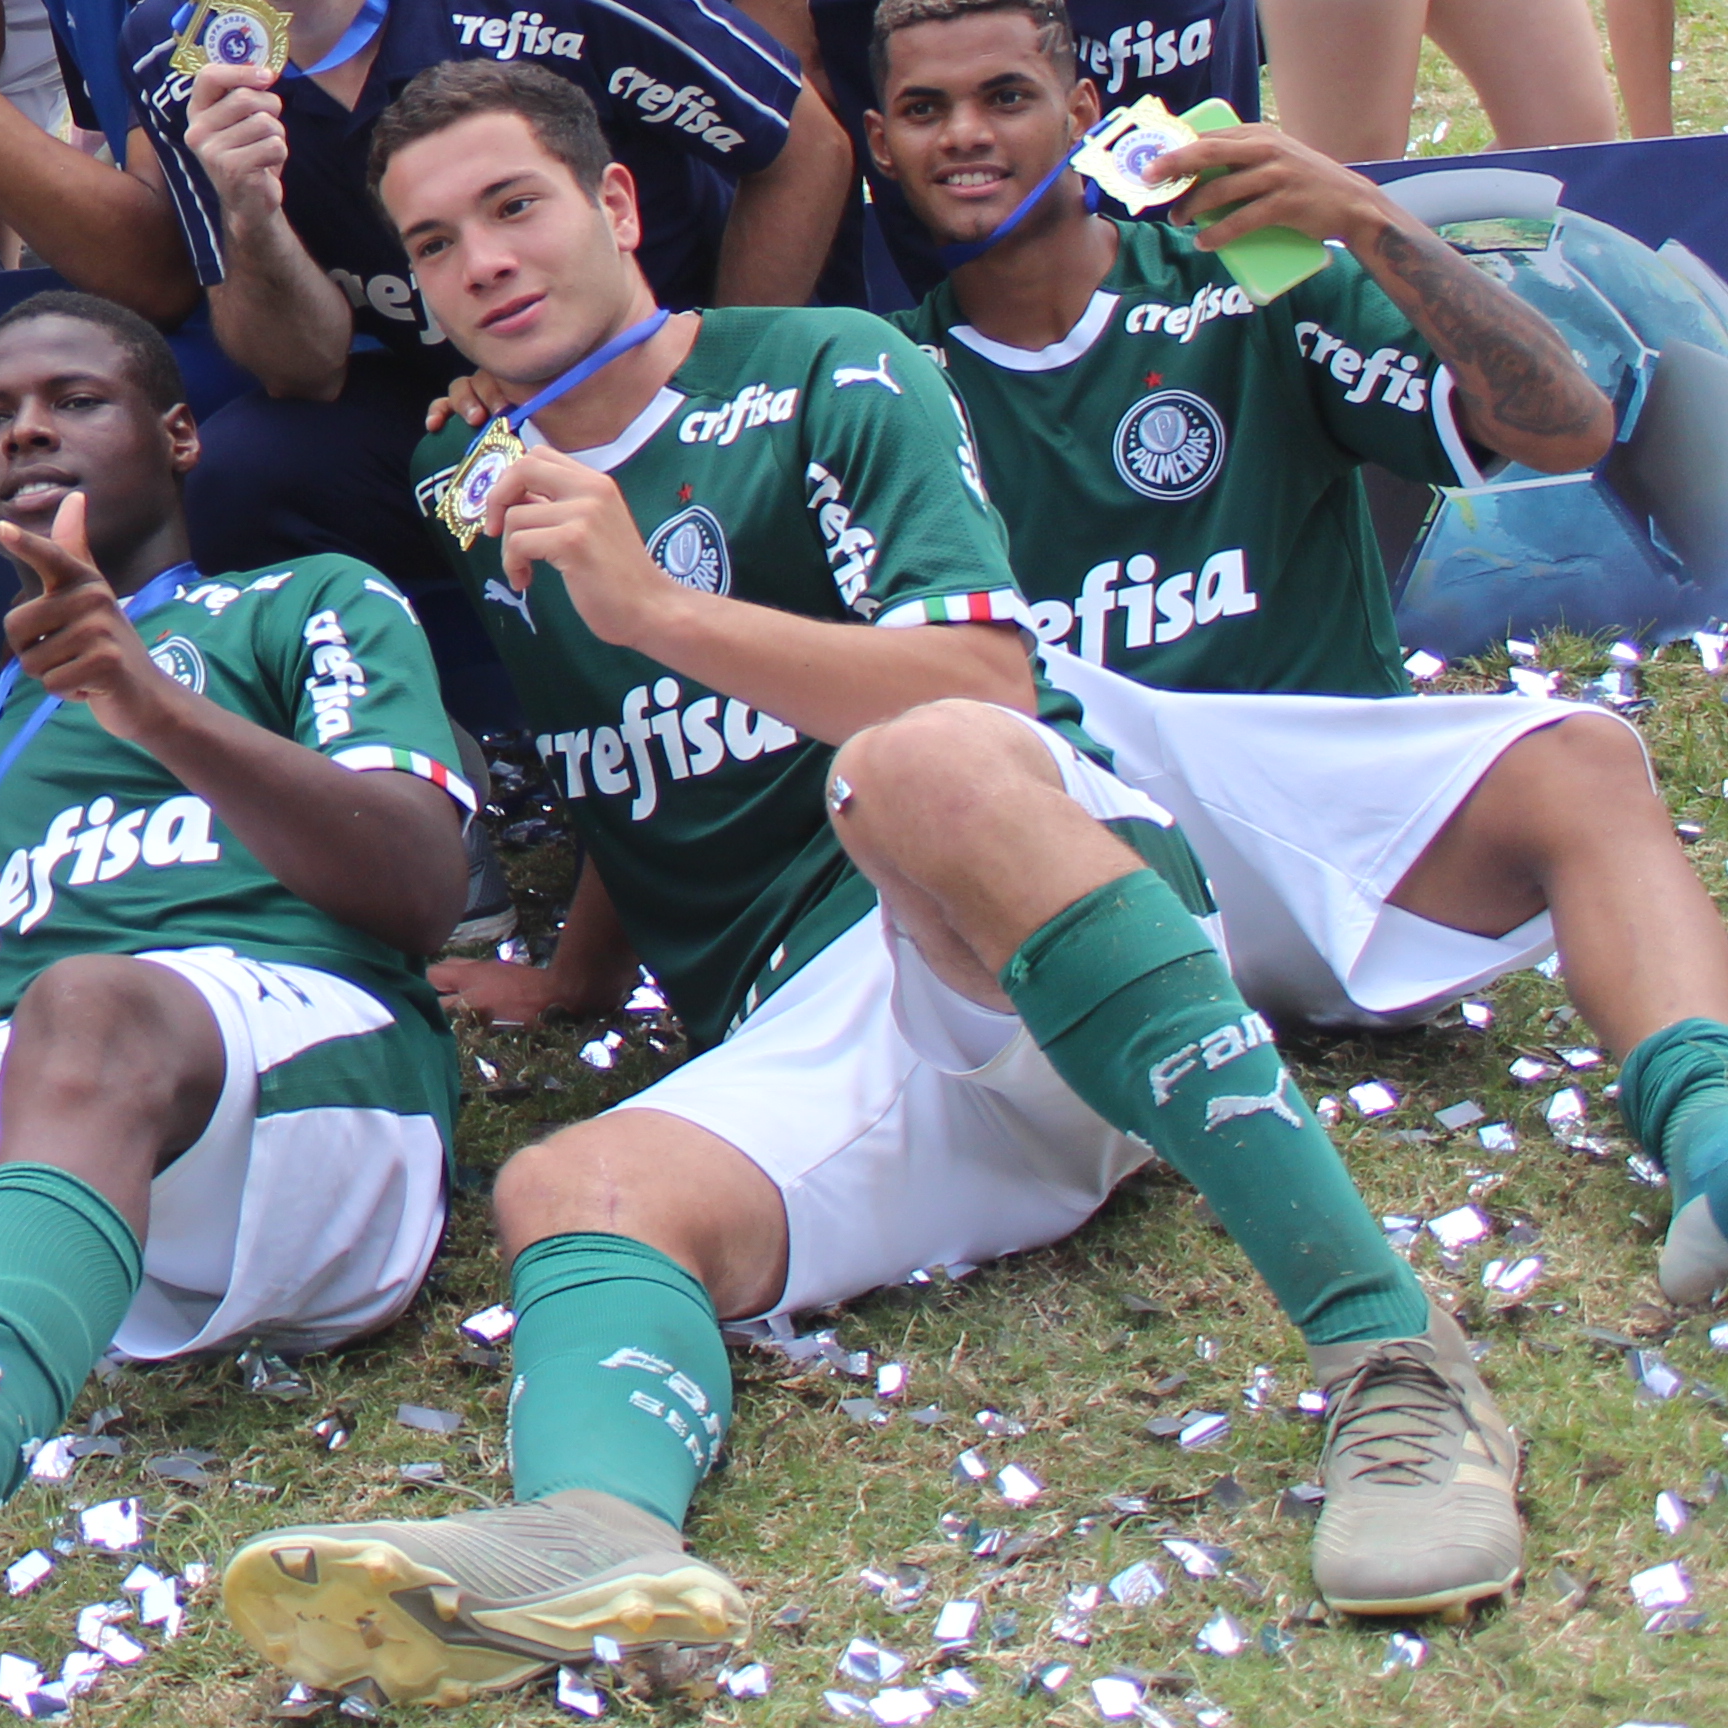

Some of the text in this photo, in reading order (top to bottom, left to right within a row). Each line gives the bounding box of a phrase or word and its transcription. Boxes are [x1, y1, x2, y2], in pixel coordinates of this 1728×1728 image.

[608, 66, 746, 154] crefisa
[1126, 426, 1212, 487] PALMEIRAS
[303, 609, 369, 745] crefisa
